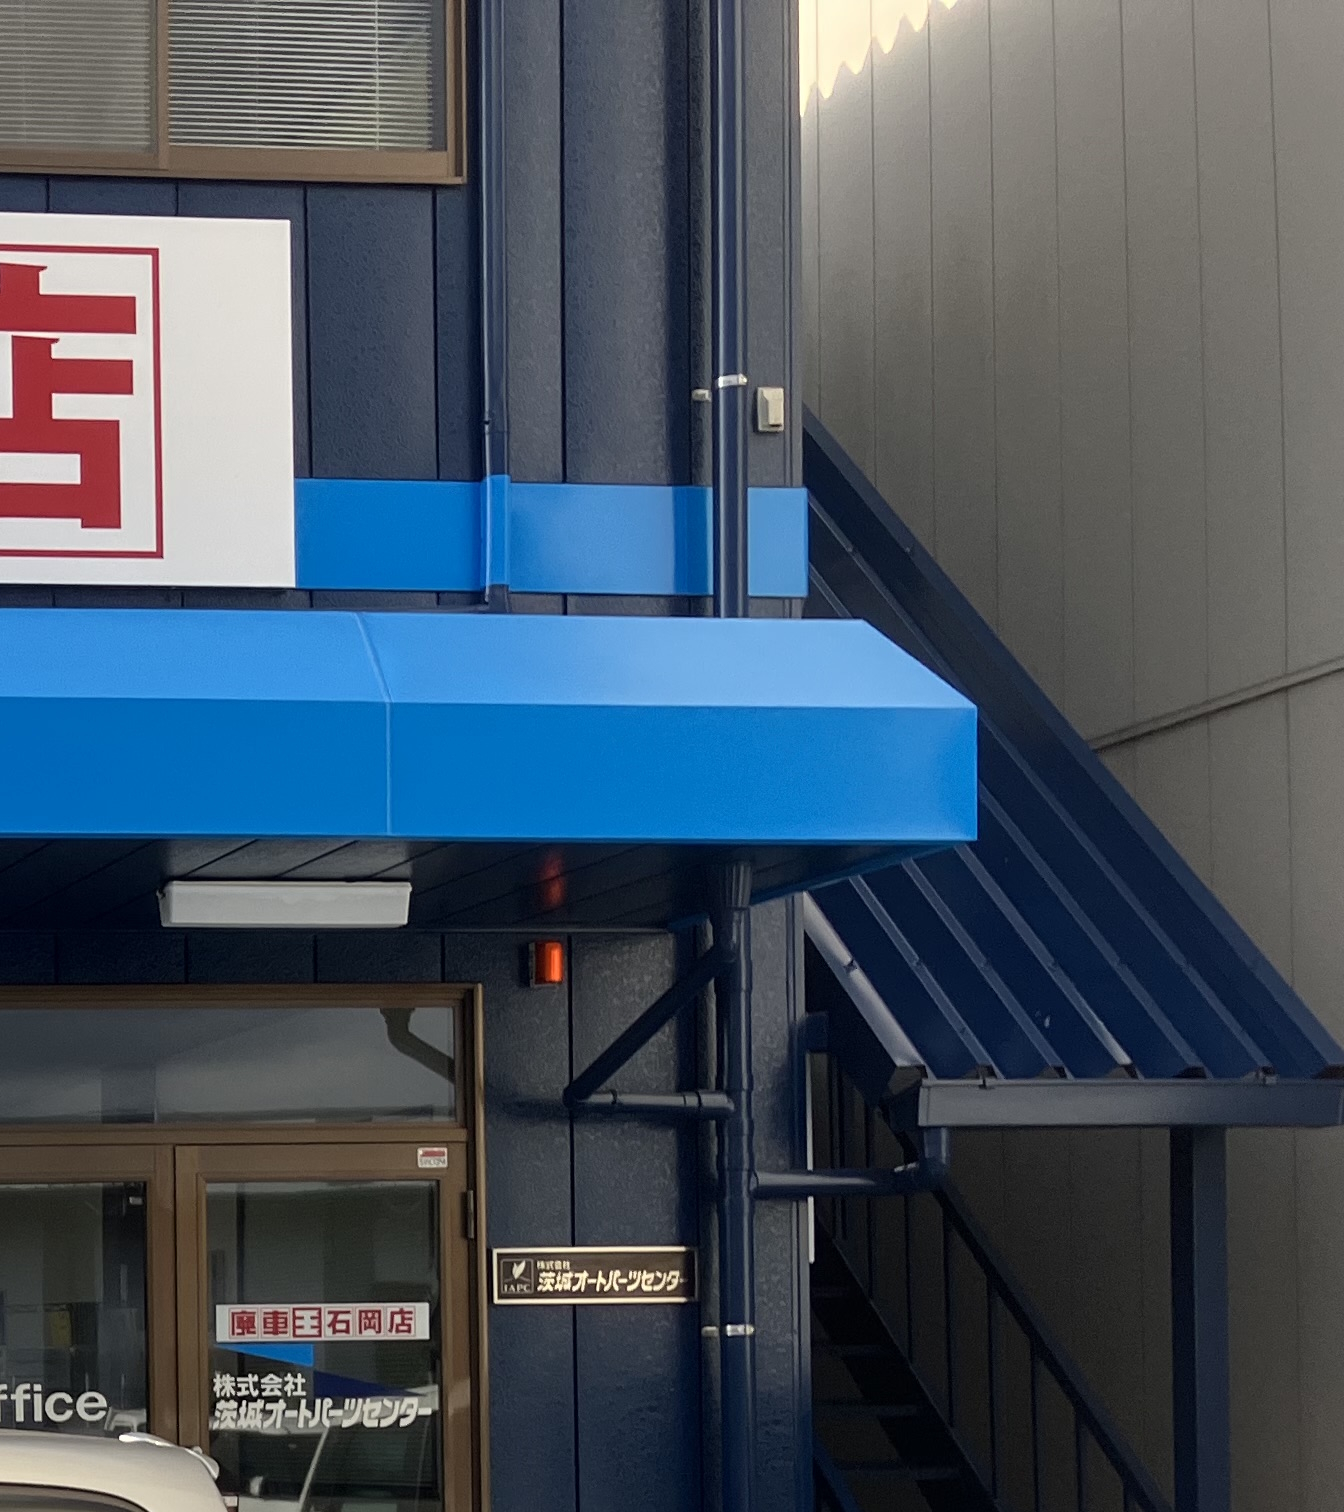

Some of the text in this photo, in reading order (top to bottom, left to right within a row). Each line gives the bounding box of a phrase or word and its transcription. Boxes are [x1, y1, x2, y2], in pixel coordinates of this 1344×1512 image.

[231, 1307, 414, 1338] 廃車王石岡店
[212, 1372, 307, 1398] 株式会社
[212, 1396, 433, 1429] 茨城オートパーツセンター
